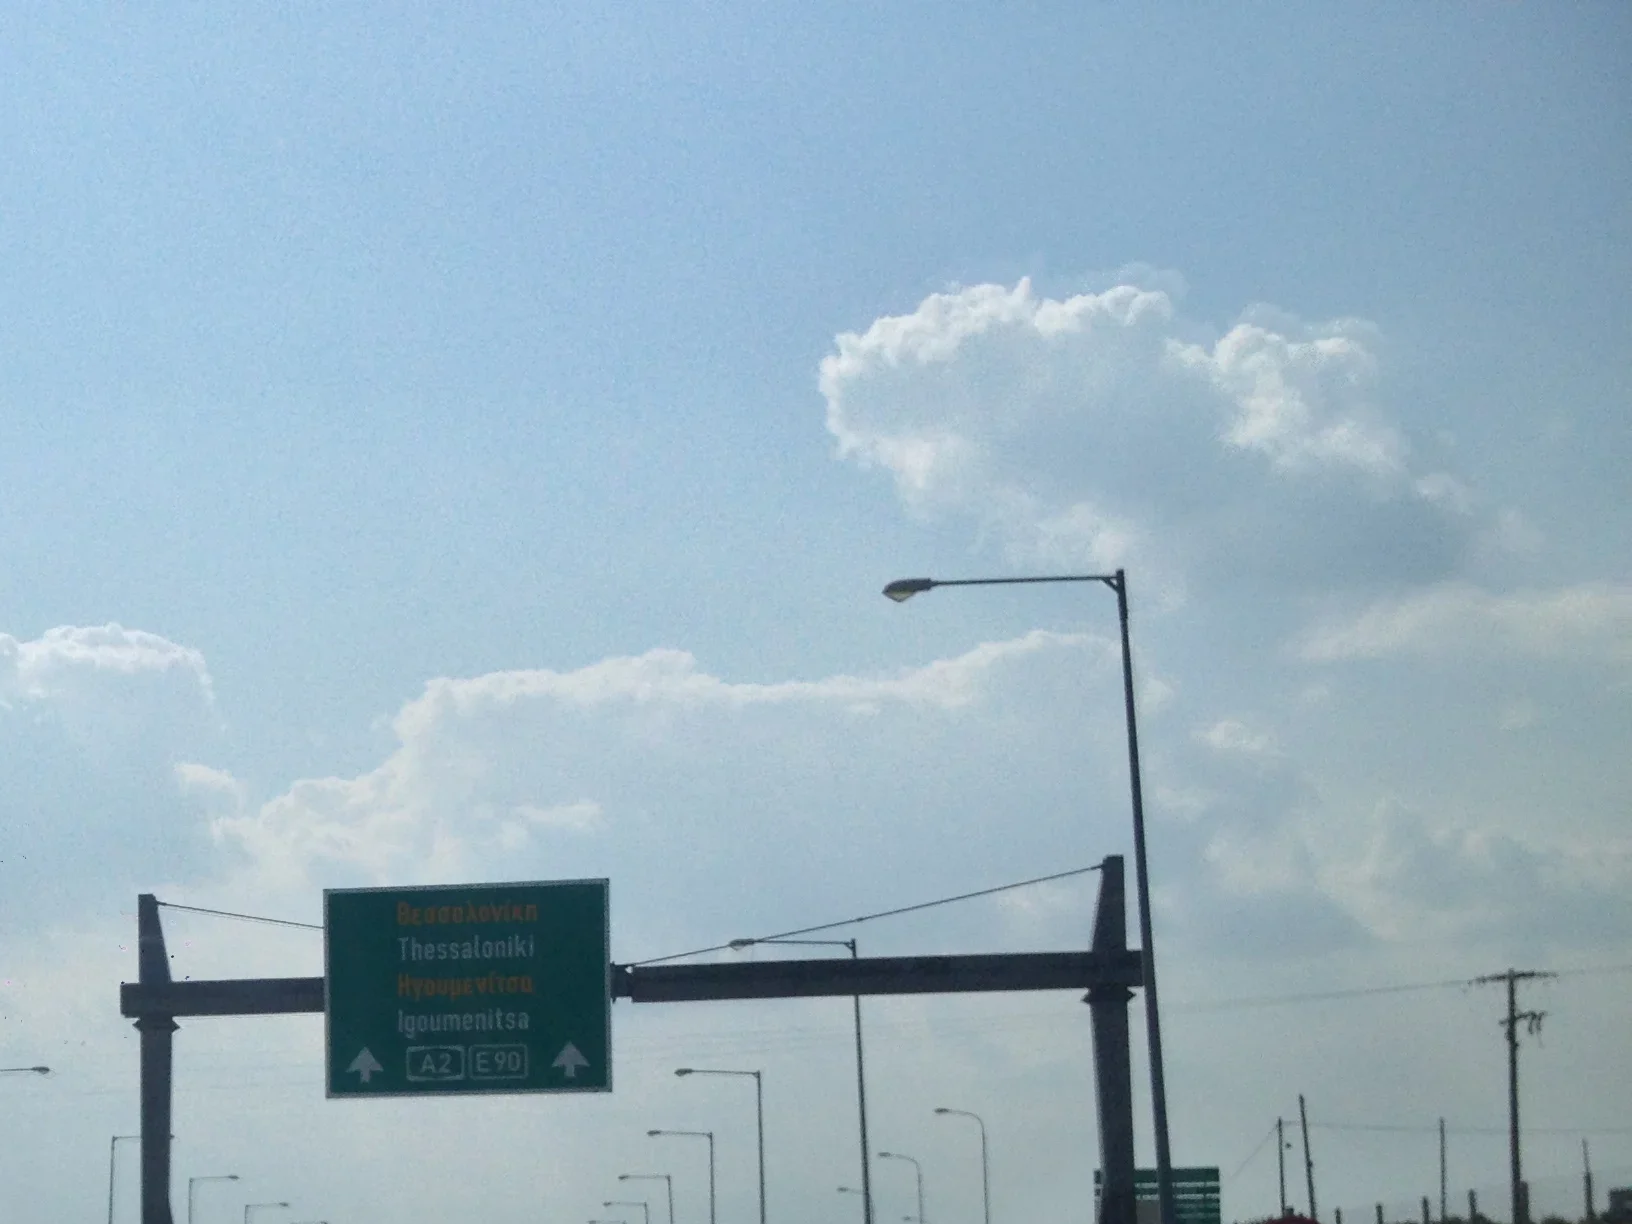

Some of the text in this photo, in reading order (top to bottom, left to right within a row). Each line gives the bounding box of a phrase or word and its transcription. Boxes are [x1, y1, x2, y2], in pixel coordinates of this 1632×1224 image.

[397, 934, 534, 960] Thessaloniki
[398, 1008, 530, 1040] Igoumenitsa
[420, 1052, 452, 1073] A2
